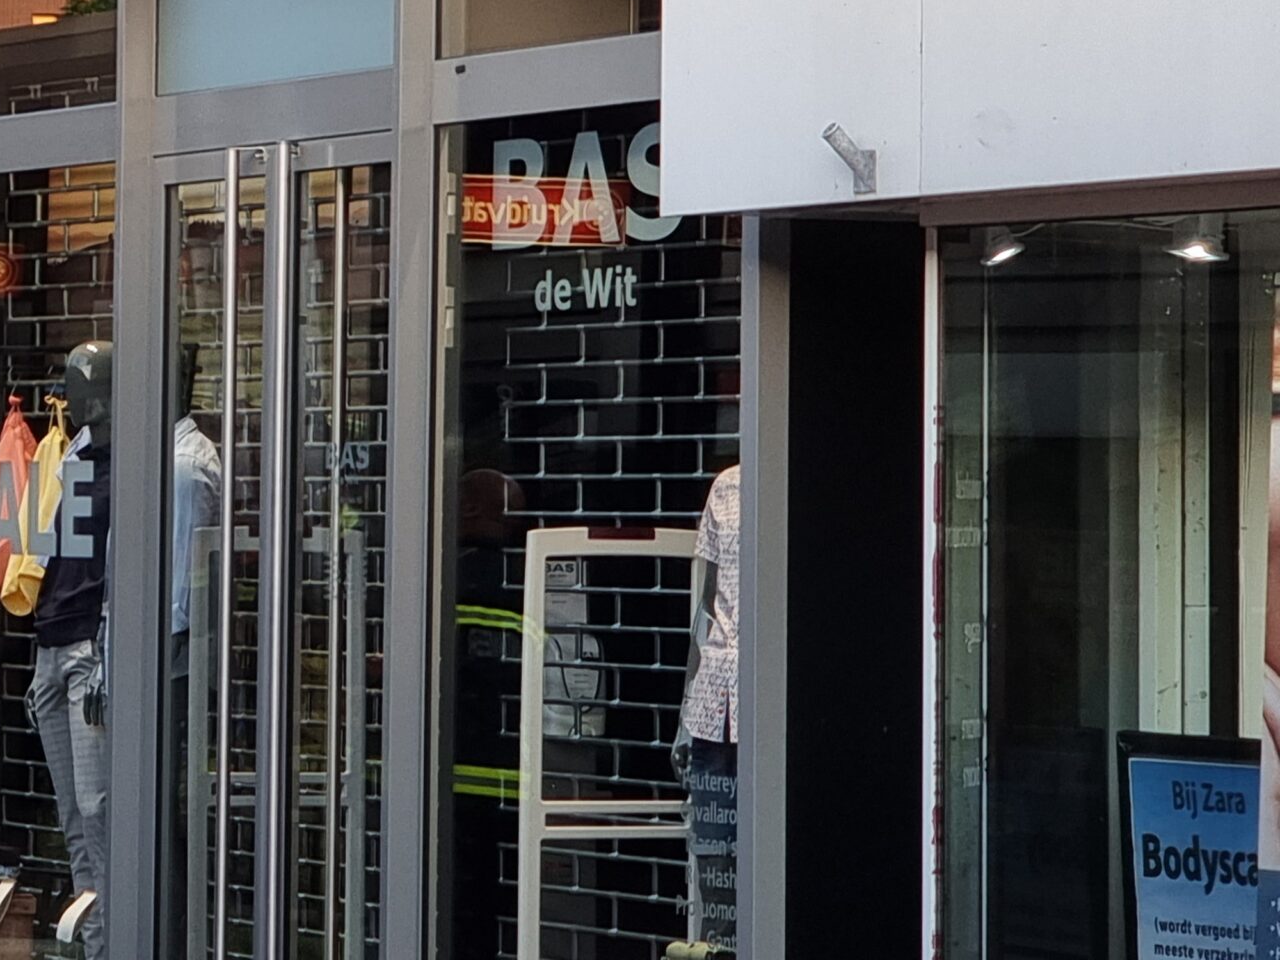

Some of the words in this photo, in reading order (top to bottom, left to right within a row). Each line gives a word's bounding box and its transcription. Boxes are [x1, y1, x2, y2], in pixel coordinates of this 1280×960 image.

[492, 121, 683, 250] BAS
[534, 269, 571, 311] de
[581, 265, 637, 308] Wit
[1172, 780, 1198, 819] Bij
[1201, 783, 1246, 814] Zara
[1154, 917, 1192, 935] (wordt
[1194, 923, 1240, 941] vergoed
[1154, 943, 1194, 958] meeste
